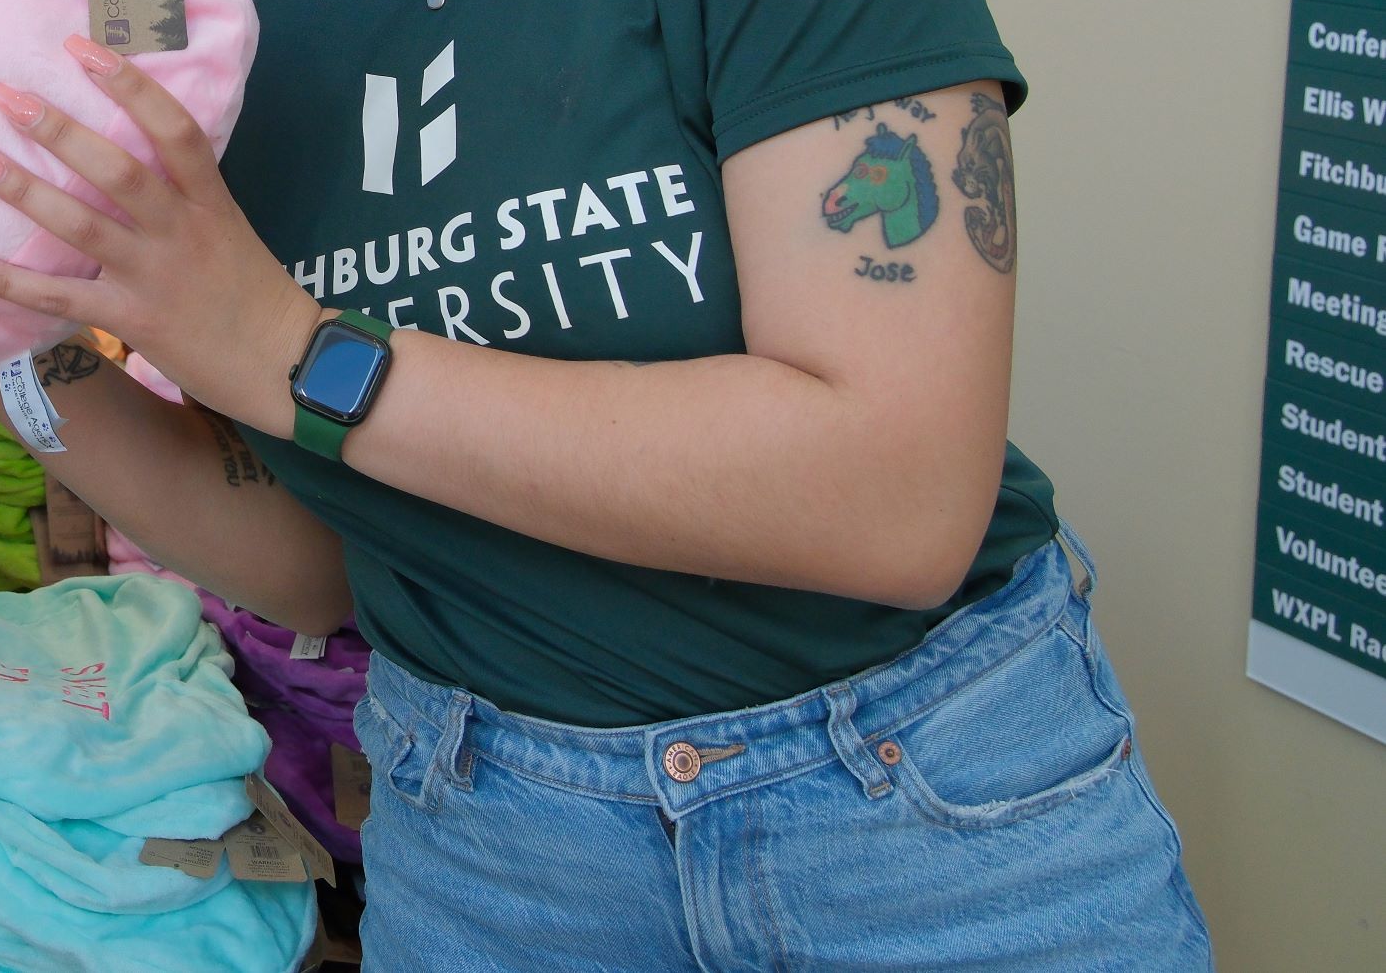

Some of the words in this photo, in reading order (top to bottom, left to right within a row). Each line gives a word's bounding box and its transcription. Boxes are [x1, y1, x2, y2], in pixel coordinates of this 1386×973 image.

[1303, 86, 1355, 121] Ellis
[1362, 97, 1386, 126] W
[1299, 150, 1386, 195] Fitchbu
[283, 211, 475, 300] HBURG
[497, 164, 695, 250] STATE
[1293, 215, 1367, 257] Game
[361, 232, 704, 345] ERSITY
[854, 255, 917, 282] Jose
[1287, 276, 1386, 336] Meeting
[1285, 339, 1383, 393] Rescue
[16, 376, 32, 415] College
[31, 416, 54, 449] Agency
[1280, 402, 1386, 462] Student
[1278, 464, 1384, 527] Student
[1276, 525, 1386, 596] Voluntee
[1272, 588, 1342, 641] WXPL
